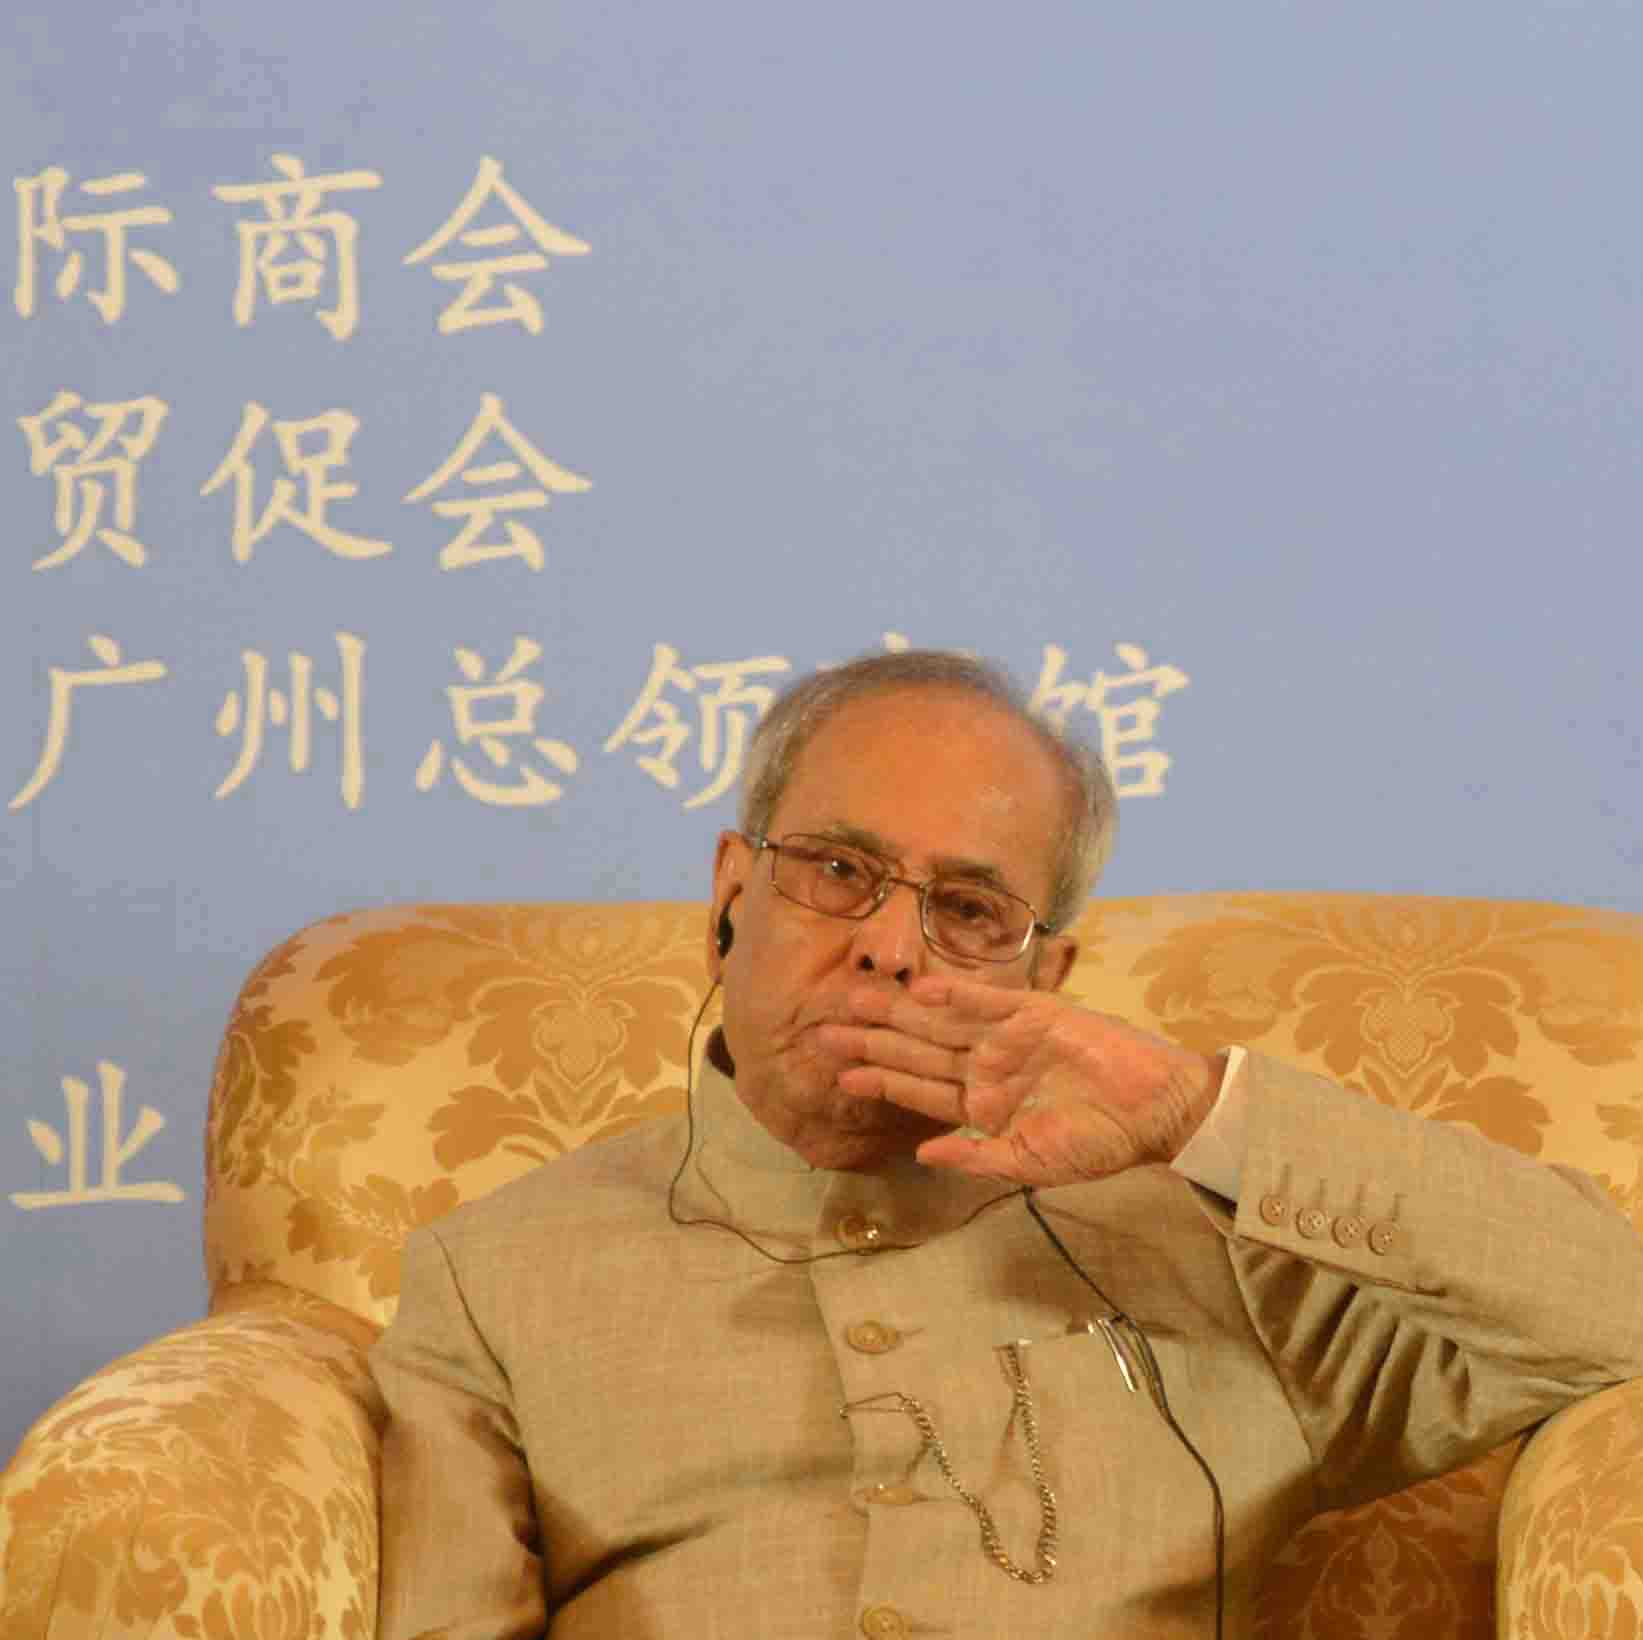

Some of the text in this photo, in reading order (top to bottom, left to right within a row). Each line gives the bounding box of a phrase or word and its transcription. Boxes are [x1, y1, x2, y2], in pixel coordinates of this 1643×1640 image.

[12, 153, 593, 340] 际商会
[18, 389, 593, 571] 贸促会
[9, 630, 1192, 811] 广州总领馆
[8, 1060, 188, 1211] 业
